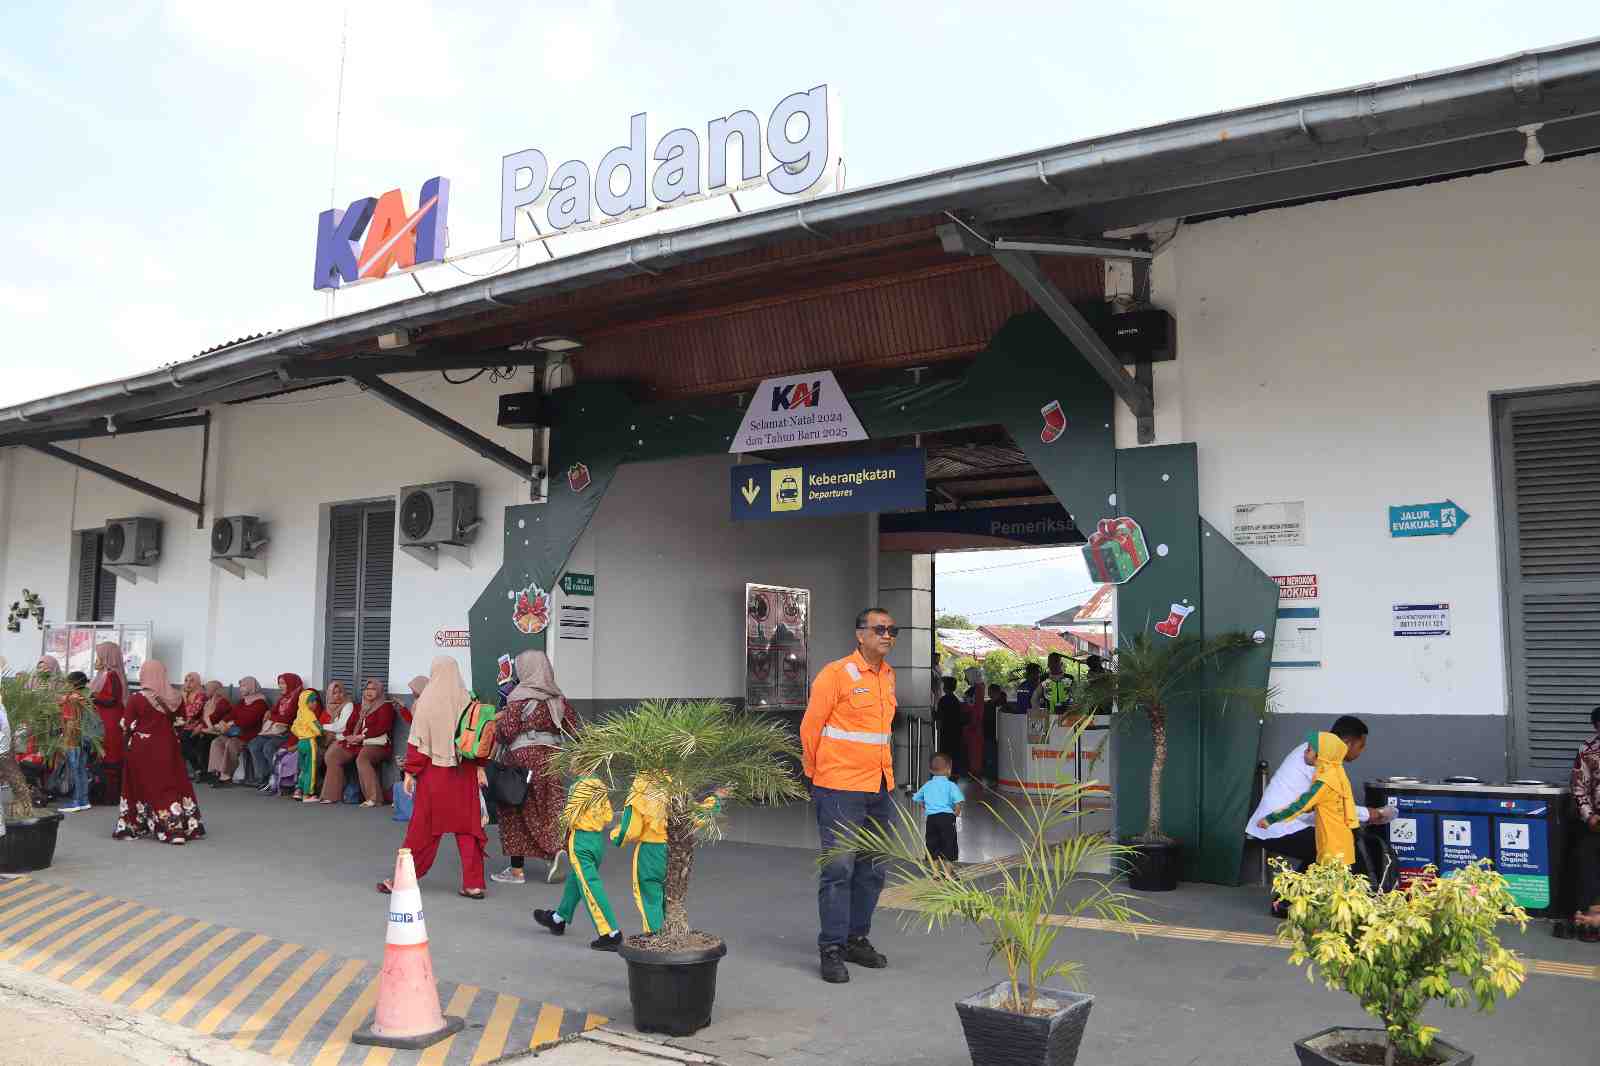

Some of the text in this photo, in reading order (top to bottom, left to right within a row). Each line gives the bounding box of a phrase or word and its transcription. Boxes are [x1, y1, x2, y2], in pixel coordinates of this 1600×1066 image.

[313, 83, 829, 291] KAI Padang
[771, 380, 821, 412] KAI
[750, 411, 843, 432] Selamat Natal 2024
[745, 427, 848, 447] dan Tahun Baru 2025
[808, 468, 896, 488] Keberangkatan
[808, 489, 853, 502] Departures
[1392, 519, 1440, 531] EVAKUASI
[1400, 510, 1431, 521] JALUR
[1286, 575, 1315, 586] MEROKOK
